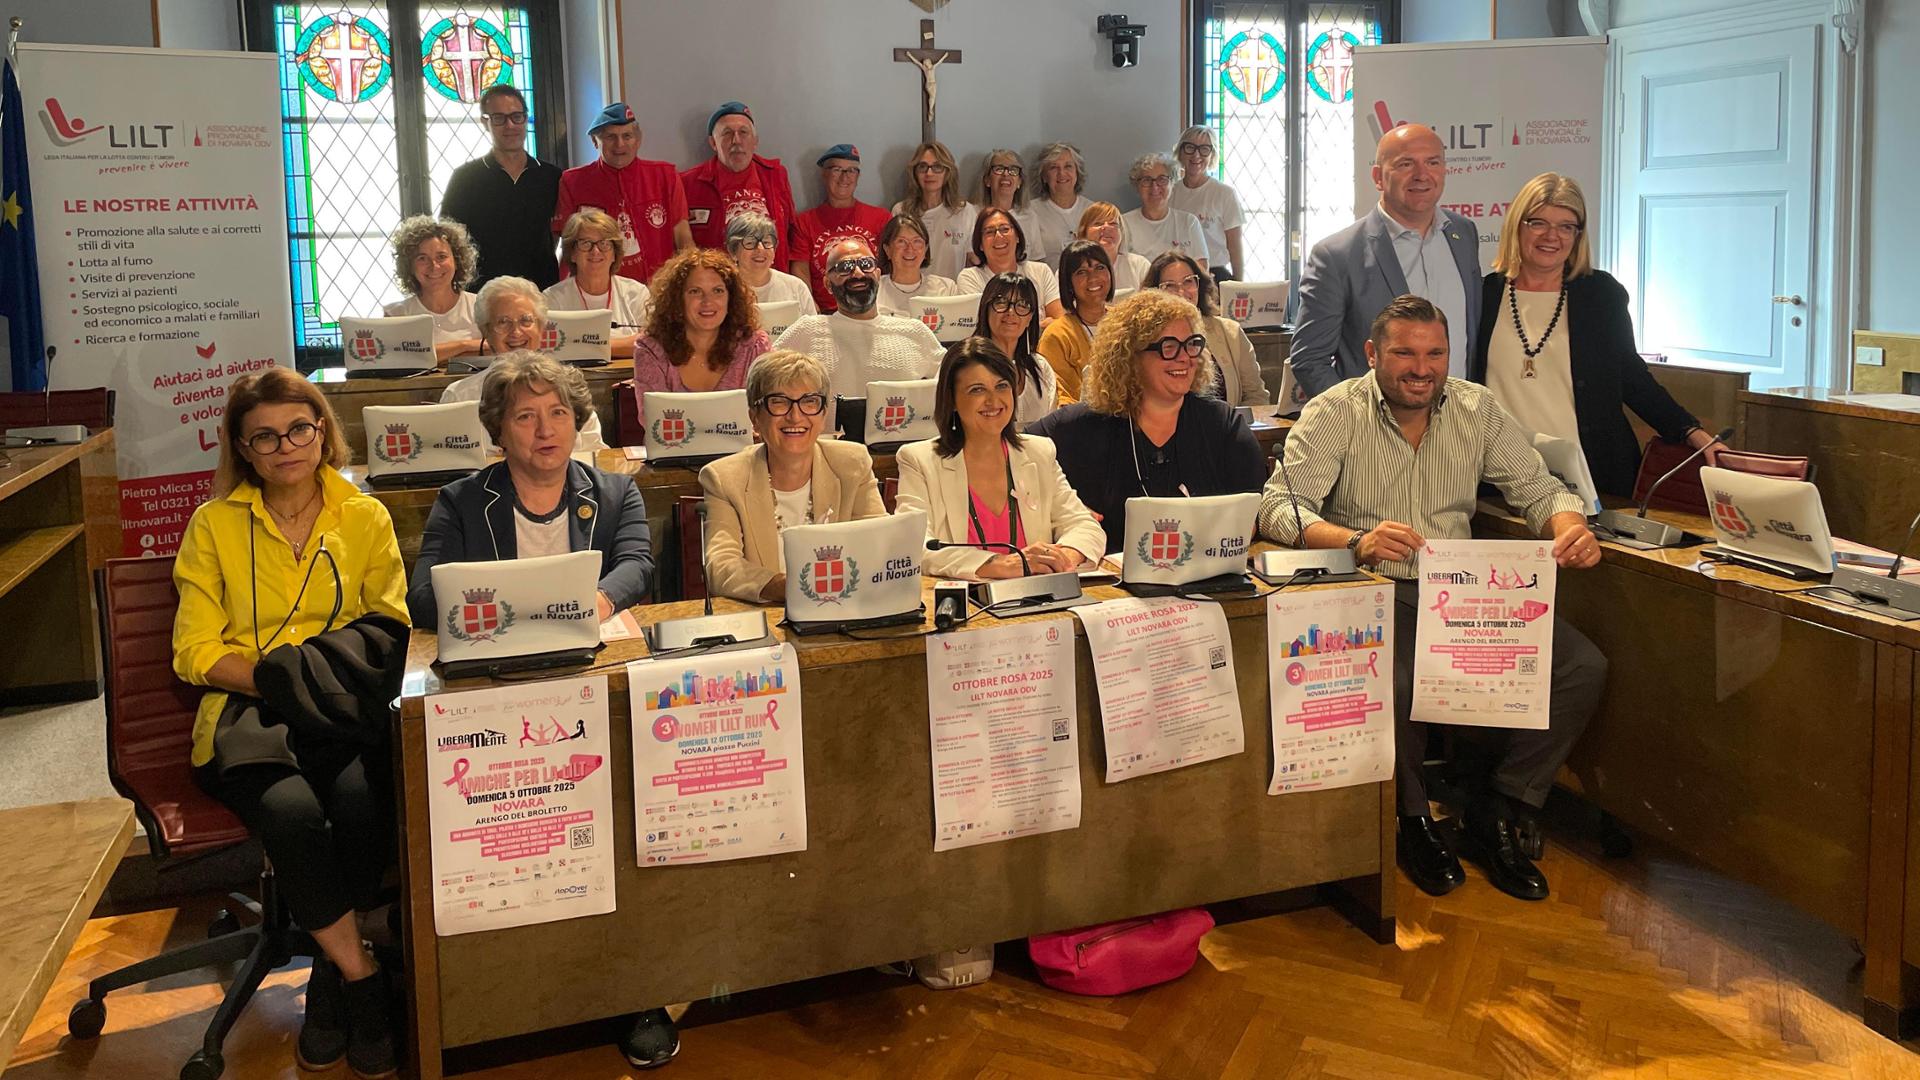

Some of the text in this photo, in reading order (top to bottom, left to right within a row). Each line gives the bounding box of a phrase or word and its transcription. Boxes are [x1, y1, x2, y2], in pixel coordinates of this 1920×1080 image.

[1526, 119, 1588, 128] ASSOCIAZIONE
[109, 125, 174, 148] LILT
[1526, 128, 1582, 136] PROVINCIALE
[1526, 137, 1534, 145] DI
[1537, 136, 1572, 144] NOVARA
[98, 163, 146, 175] prevenire
[158, 160, 190, 169] vivere
[1476, 162, 1506, 170] vivere
[64, 194, 259, 213] LE NOSTRE ATTIVITÀ
[78, 226, 144, 238] Promozione
[146, 226, 165, 236] alla
[168, 225, 200, 236] salute
[211, 225, 221, 234] ai
[223, 224, 262, 234] corretti
[78, 240, 134, 251] stili di vita
[813, 230, 832, 258] CITY
[80, 256, 153, 268] Lotta al fumo
[80, 270, 196, 284] Visite di prevenzione
[82, 286, 178, 300] Servizi ai pazienti
[83, 304, 136, 316] Sostegno
[204, 300, 240, 310] sociale
[84, 310, 260, 328] ed economico a malati e familiari
[86, 330, 200, 345] Ricerca e formazione
[153, 356, 275, 390] Aiutaci ad aiutare
[172, 384, 225, 406] diventa
[180, 414, 190, 424] e
[445, 434, 469, 443] Città
[445, 441, 480, 449] Novara
[122, 488, 157, 500] Pietro
[160, 484, 194, 495] Micca
[142, 501, 158, 512] Tel
[161, 497, 191, 509] 0321
[122, 512, 182, 530] iltnovara.it
[158, 532, 180, 544] LILT
[1220, 536, 1244, 548] Città
[1206, 548, 1216, 556] di
[886, 556, 912, 570] Città
[872, 565, 920, 584] di Novara
[546, 600, 580, 614] Città
[546, 608, 594, 620] Novara
[1107, 602, 1199, 628] OTTOBRE ROSA 2025
[1142, 621, 1172, 632] NOVARA
[1174, 616, 1188, 626] ODV
[1464, 628, 1502, 637] NOVARA
[952, 669, 1054, 692] OTTOBRE ROSA 2025
[970, 693, 986, 702] LILT
[986, 688, 1018, 698] NOVARA
[1020, 685, 1037, 694] ODV
[451, 706, 468, 716] LILT
[720, 716, 742, 733] LILT
[745, 713, 766, 730] RUN
[710, 736, 718, 744] 12
[682, 745, 712, 756] NOVARA
[737, 740, 760, 749] Puccini
[459, 769, 510, 794] AMICHE
[514, 769, 540, 786] PER
[466, 782, 576, 804] DOMENICA 5 OTTOBRE 2025
[494, 798, 546, 814] NOVARA
[476, 806, 568, 824] ARENGO DEL BROLETTO
